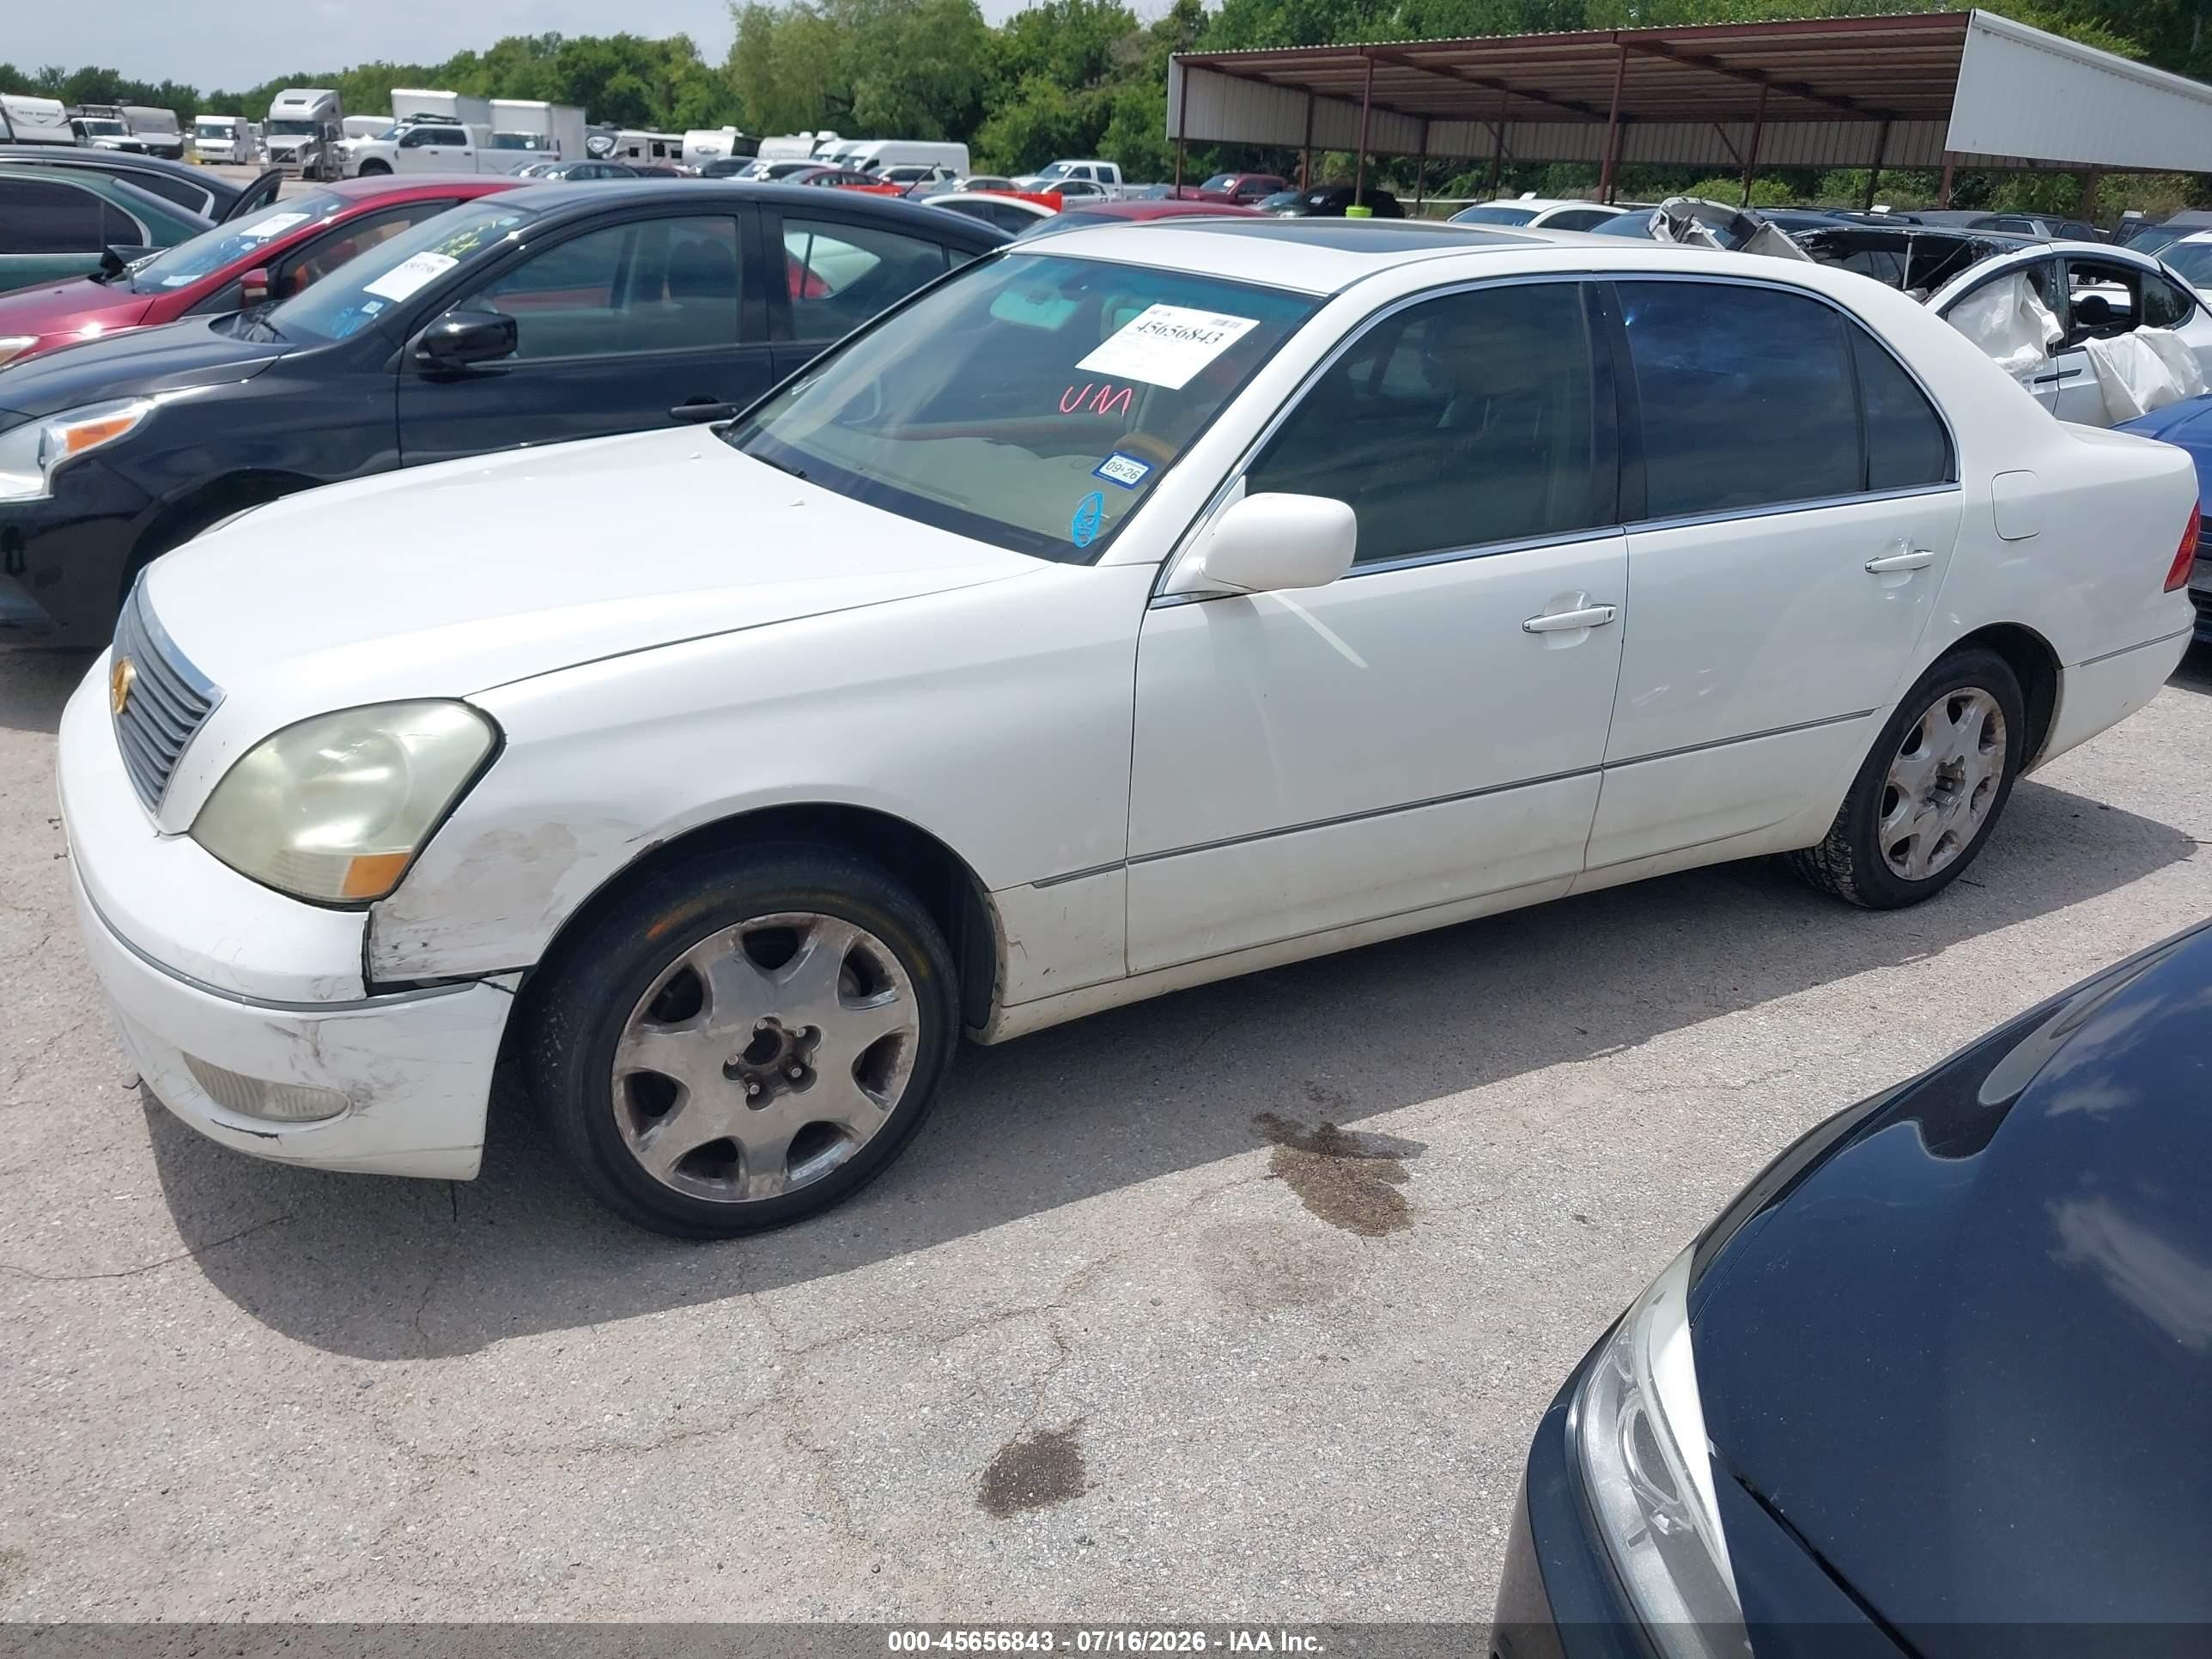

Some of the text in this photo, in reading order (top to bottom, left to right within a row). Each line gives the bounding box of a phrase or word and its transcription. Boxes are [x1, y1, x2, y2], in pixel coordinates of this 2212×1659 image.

[1136, 320, 1224, 344] 45656843
[1105, 461, 1122, 473] 09
[1122, 467, 1141, 480] 26
